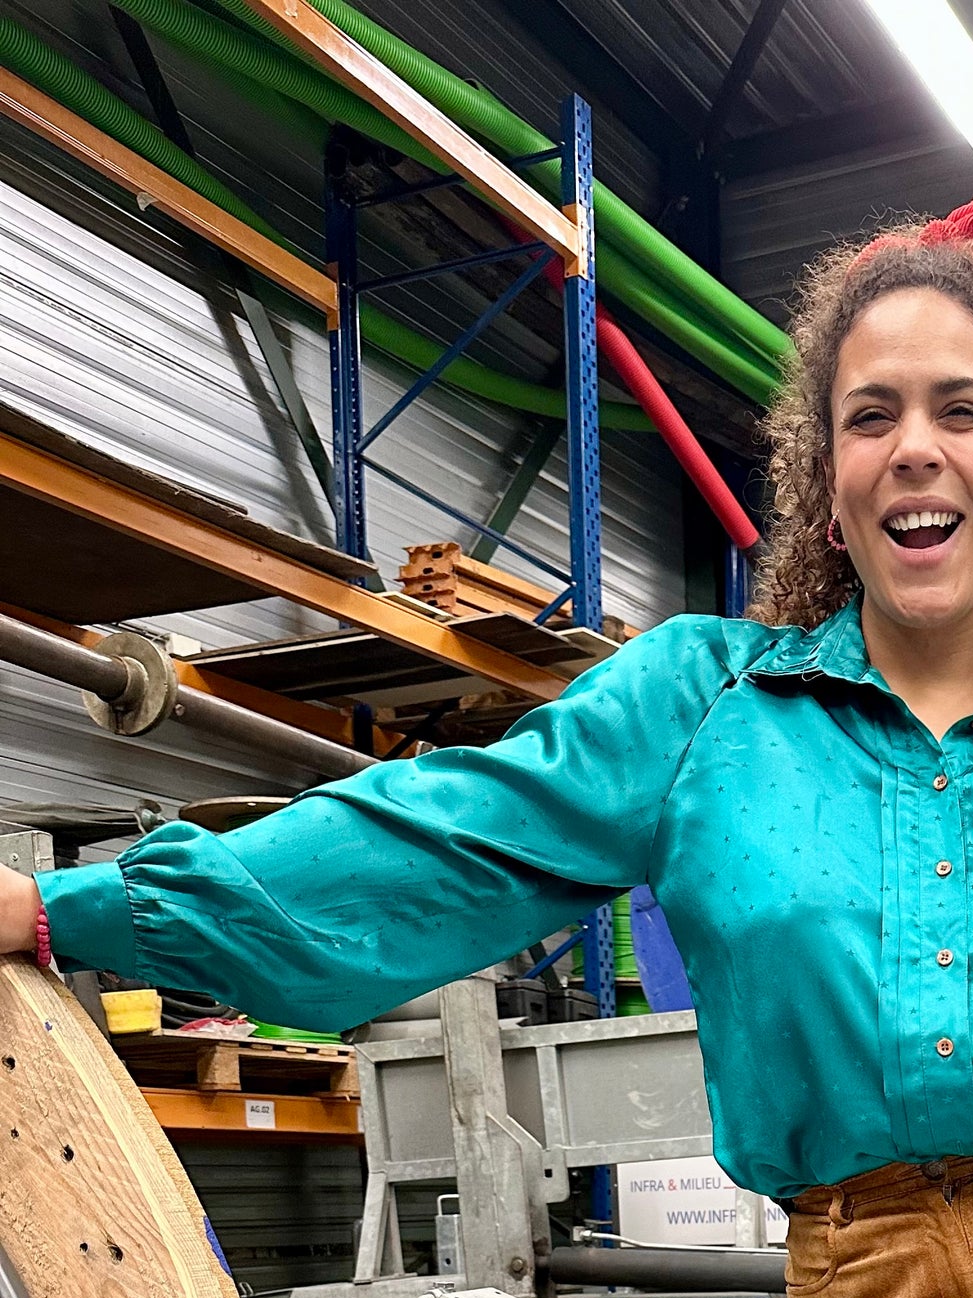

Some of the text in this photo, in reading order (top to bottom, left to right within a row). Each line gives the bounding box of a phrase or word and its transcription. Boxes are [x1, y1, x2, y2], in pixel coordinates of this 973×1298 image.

[630, 1177, 721, 1193] INFRA & MILIEU
